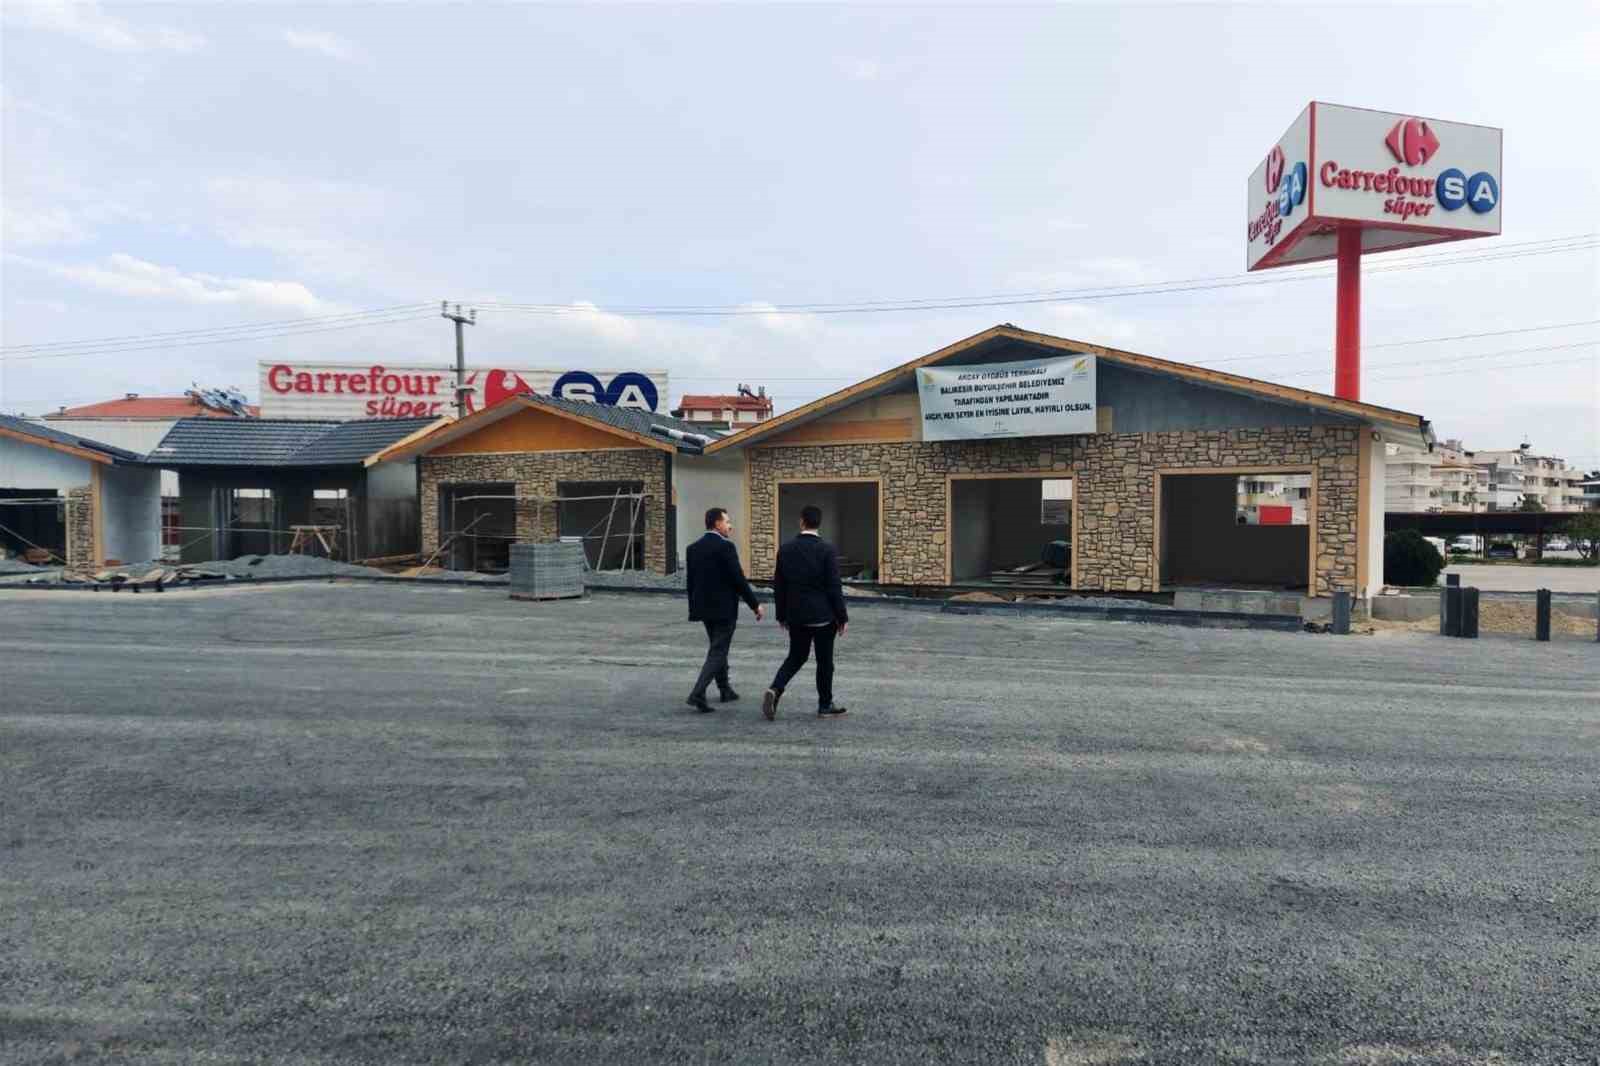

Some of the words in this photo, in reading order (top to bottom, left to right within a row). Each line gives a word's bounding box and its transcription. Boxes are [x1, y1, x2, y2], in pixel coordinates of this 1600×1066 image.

[1320, 160, 1435, 198] Carrefour
[1383, 196, 1435, 221] süper
[267, 364, 441, 396] Carrefour
[366, 395, 442, 417] süper
